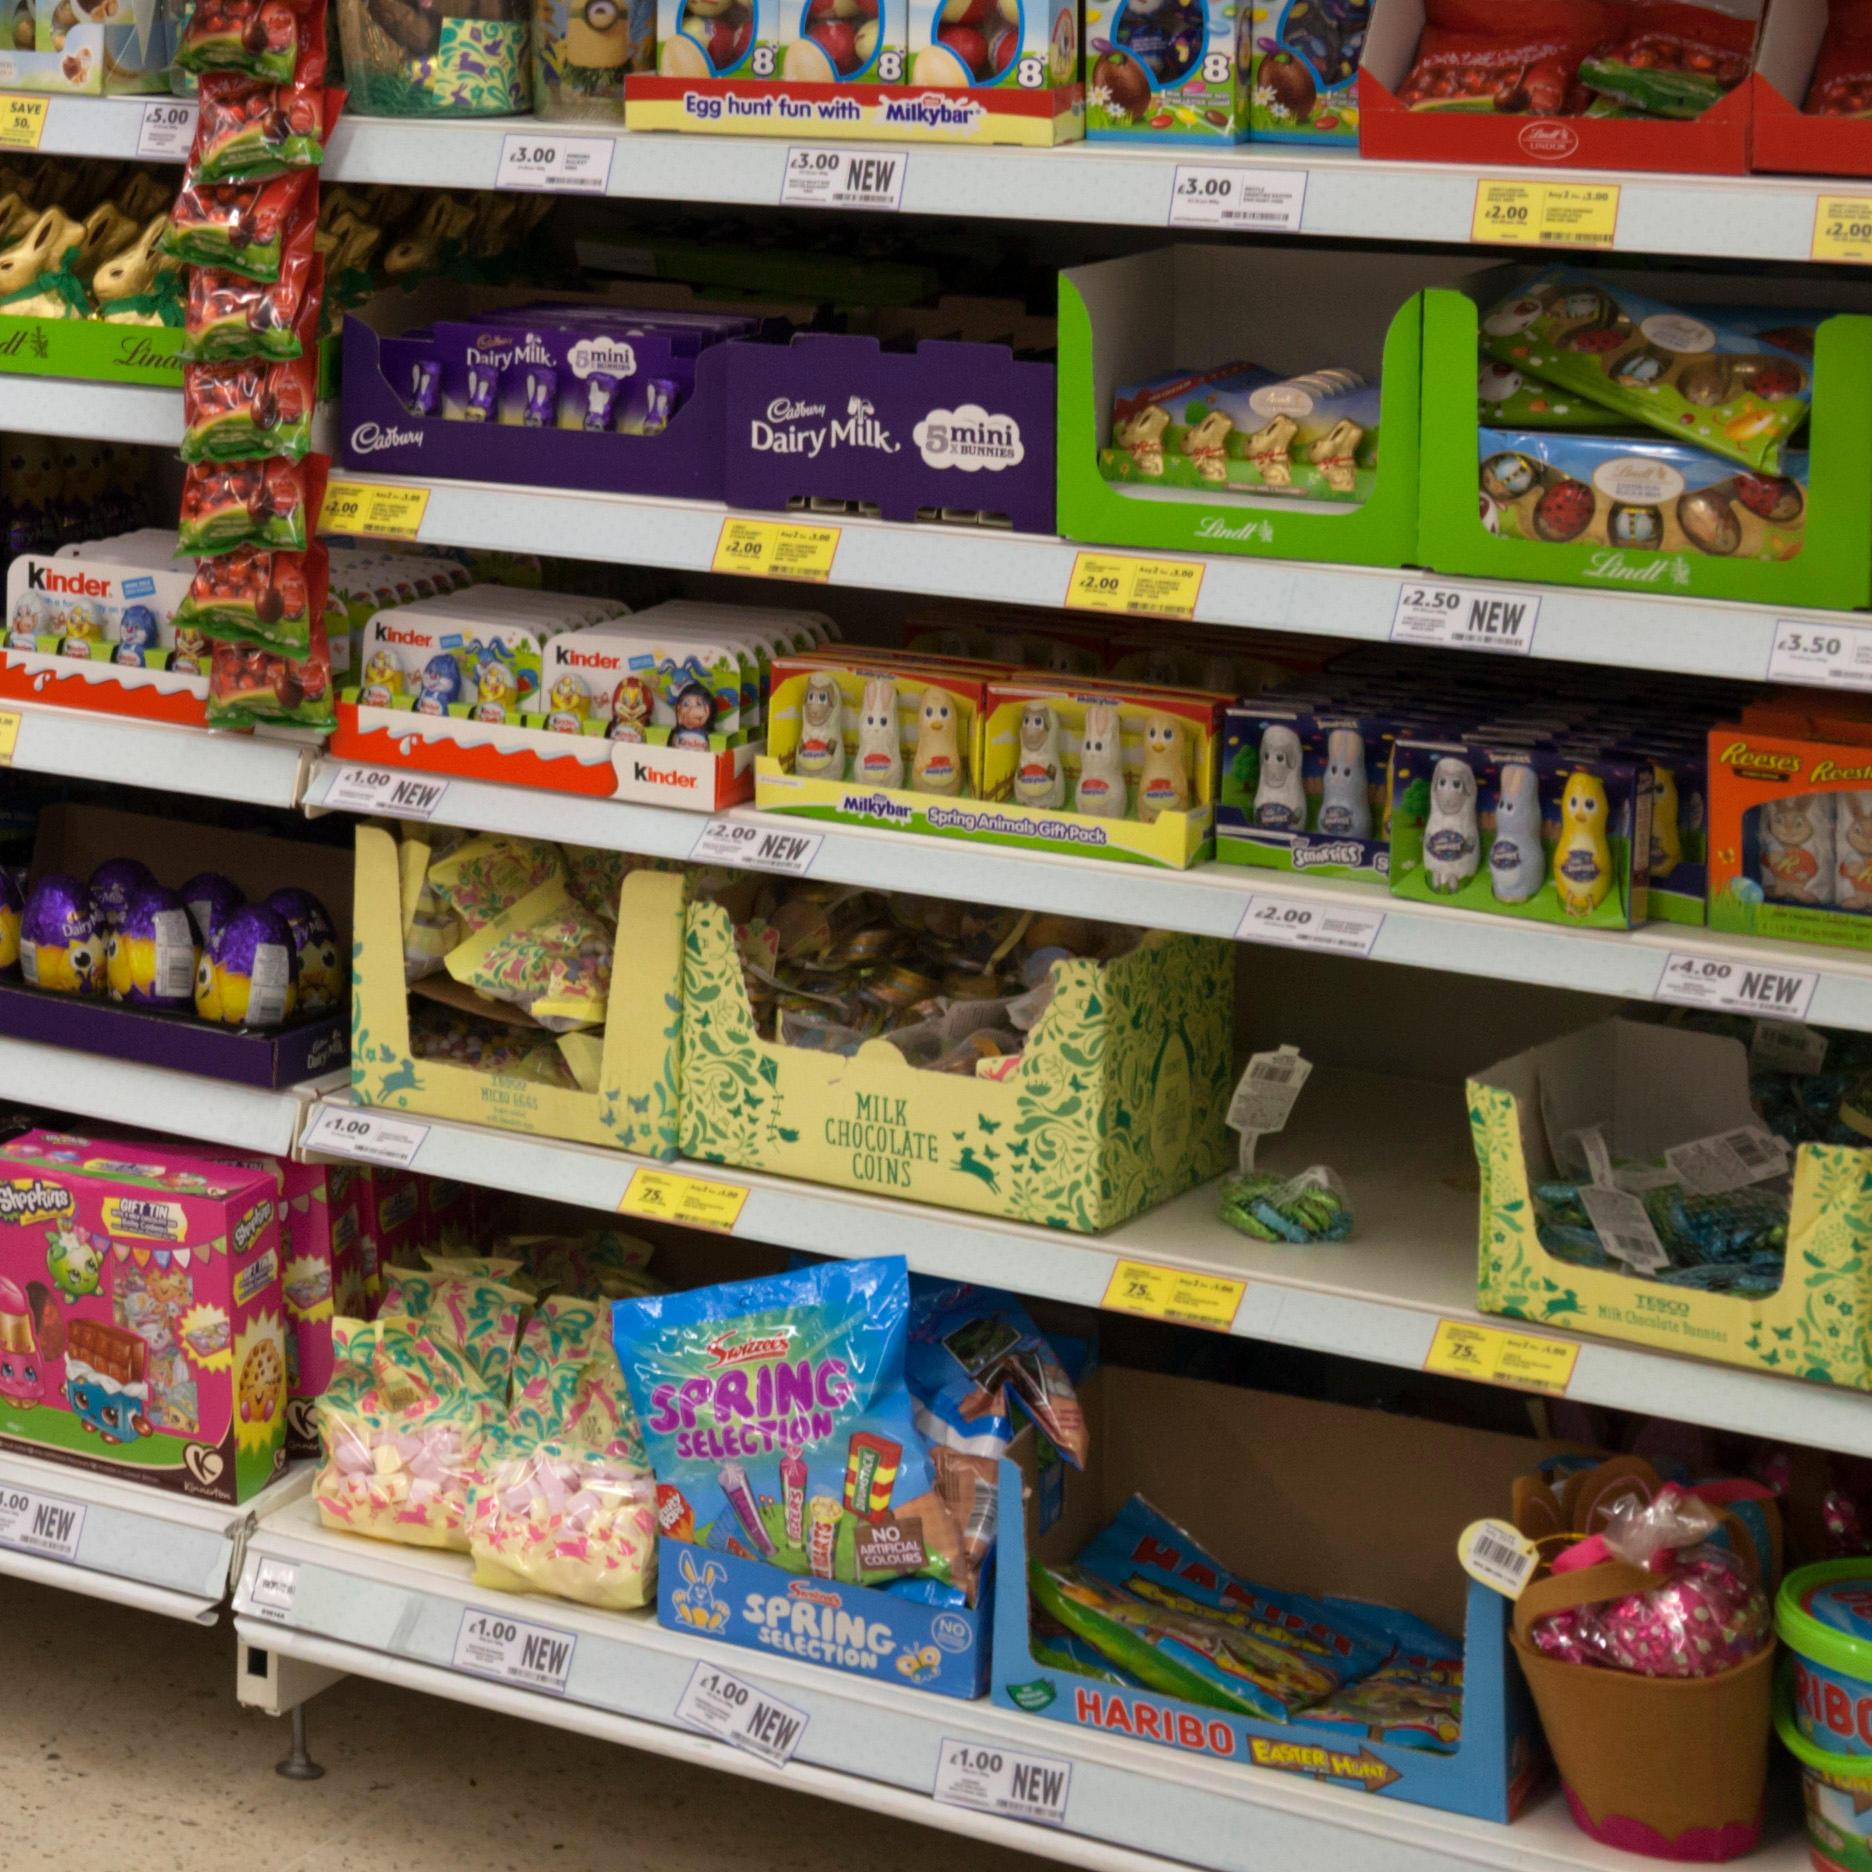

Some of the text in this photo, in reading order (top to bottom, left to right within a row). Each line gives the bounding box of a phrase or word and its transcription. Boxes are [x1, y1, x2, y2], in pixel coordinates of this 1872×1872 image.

[10, 100, 43, 116] SAVE
[685, 94, 977, 127] Egg hunt fun with Milkybar
[790, 152, 840, 170] £3.00
[846, 159, 895, 193] NEW
[766, 398, 826, 424] Cadbury
[350, 422, 424, 455] Cadbury
[751, 420, 822, 459] Dairy
[925, 415, 1014, 454] 5 mini
[959, 443, 1016, 460] BUNNIES
[1582, 550, 1669, 585] Lindt
[1403, 589, 1461, 613] £2.50
[1467, 601, 1523, 637] NEW
[1720, 741, 1802, 774] Reese's
[843, 794, 1067, 840] Milkybar Spring Animals Gift
[855, 1092, 907, 1124] MILK
[824, 1118, 938, 1163] CHOCOLATE
[852, 1152, 912, 1189] COINS
[649, 1358, 856, 1434] SPRING
[676, 1413, 836, 1460] SELECTION
[858, 1539, 923, 1559] ARTIFICIAL
[869, 1524, 901, 1545] NO
[863, 1552, 923, 1570] COLOURS
[742, 1593, 897, 1654] SPRING
[468, 1616, 517, 1644] £1.00
[520, 1634, 568, 1677] NEW
[757, 1625, 878, 1671] SELECTION
[1075, 1689, 1387, 1782] HARIBO EASTER HUNT
